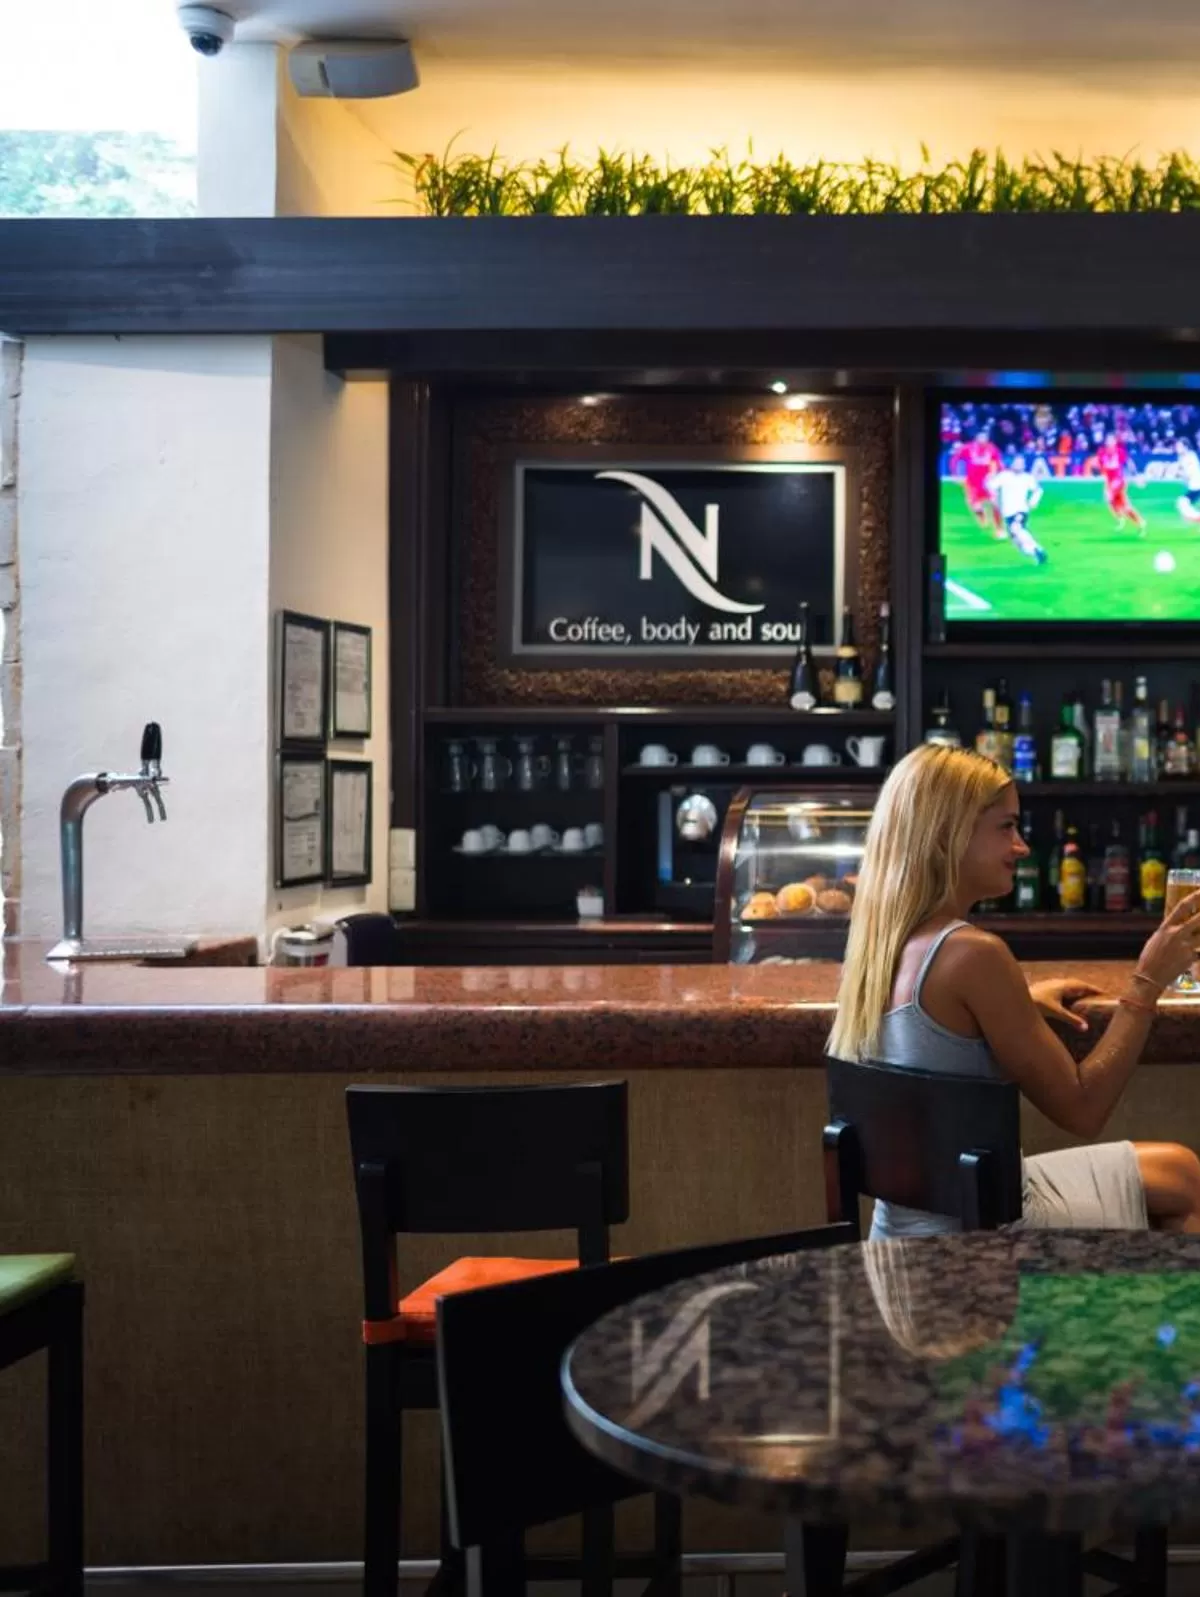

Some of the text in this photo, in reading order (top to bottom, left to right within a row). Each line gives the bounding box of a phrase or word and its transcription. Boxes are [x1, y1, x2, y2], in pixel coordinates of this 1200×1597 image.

[594, 470, 766, 614] N
[549, 615, 807, 646] Coffee, body and sou
